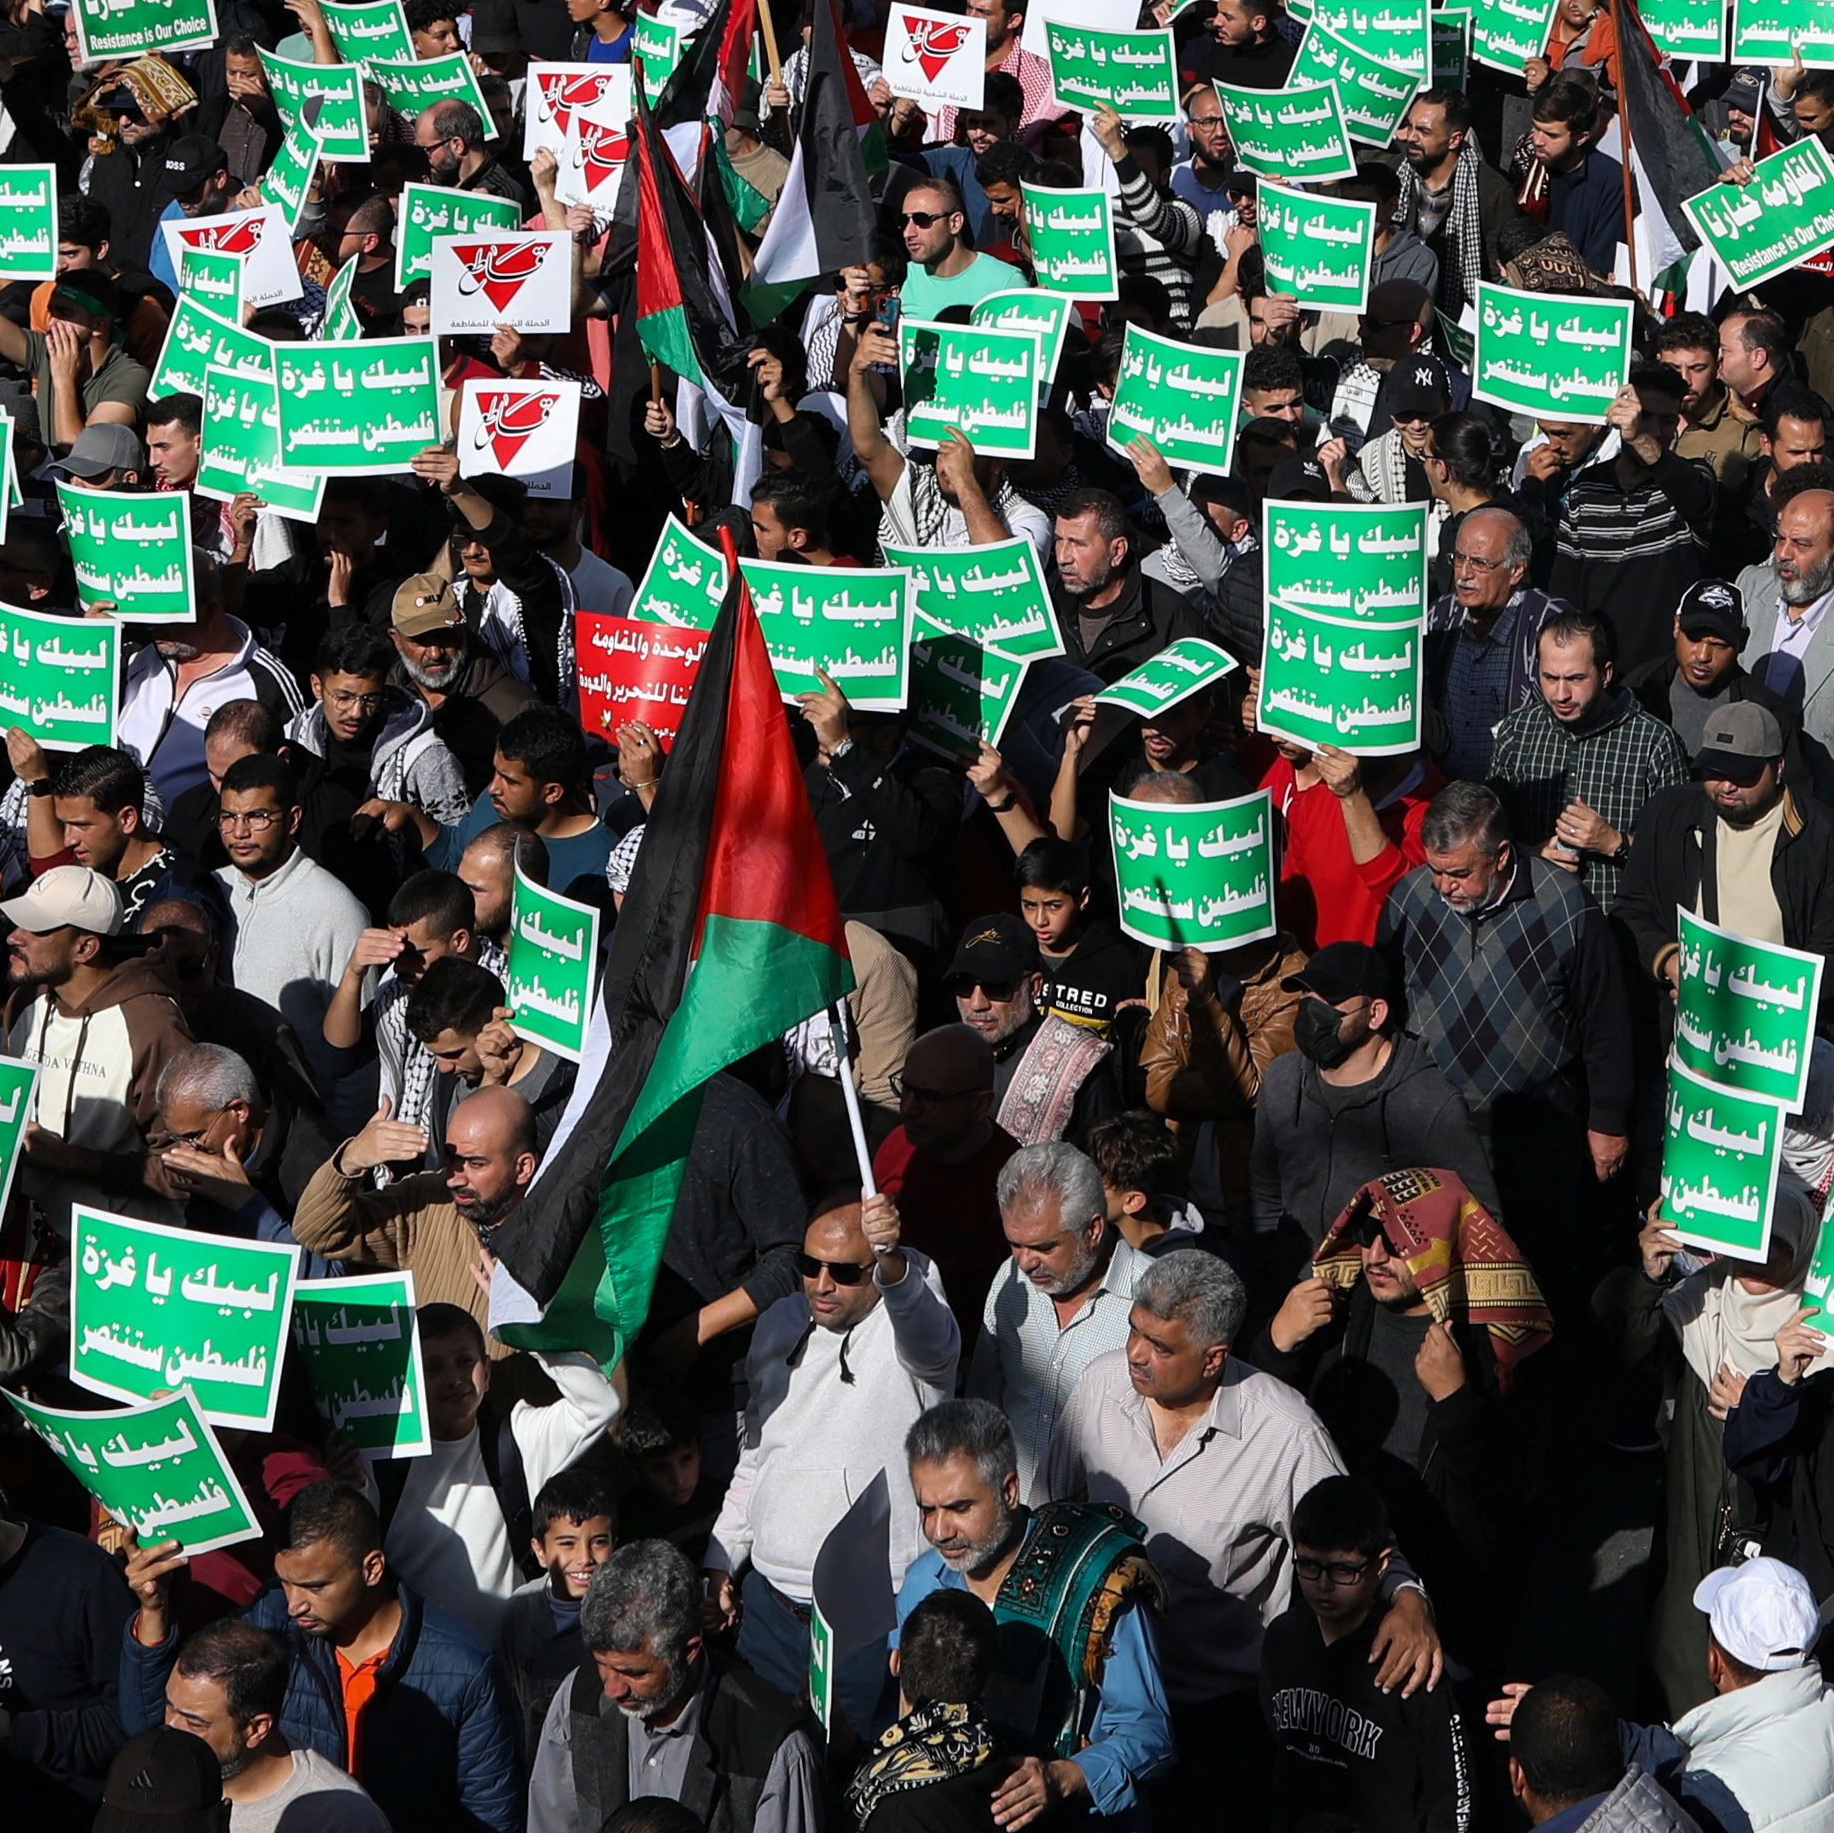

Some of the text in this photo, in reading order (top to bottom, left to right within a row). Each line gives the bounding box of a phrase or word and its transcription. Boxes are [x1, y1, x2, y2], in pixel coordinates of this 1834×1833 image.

[89, 15, 207, 51] Resistance is Our Choice
[450, 319, 489, 328] للمقاطعة
[525, 319, 550, 328] الحملة
[280, 355, 431, 399] لبيك يا غزة
[285, 410, 436, 453] فلسطين ستنتصر
[592, 623, 707, 667] الوحدة والمقاومة
[579, 667, 668, 703] للتحرير والعودة
